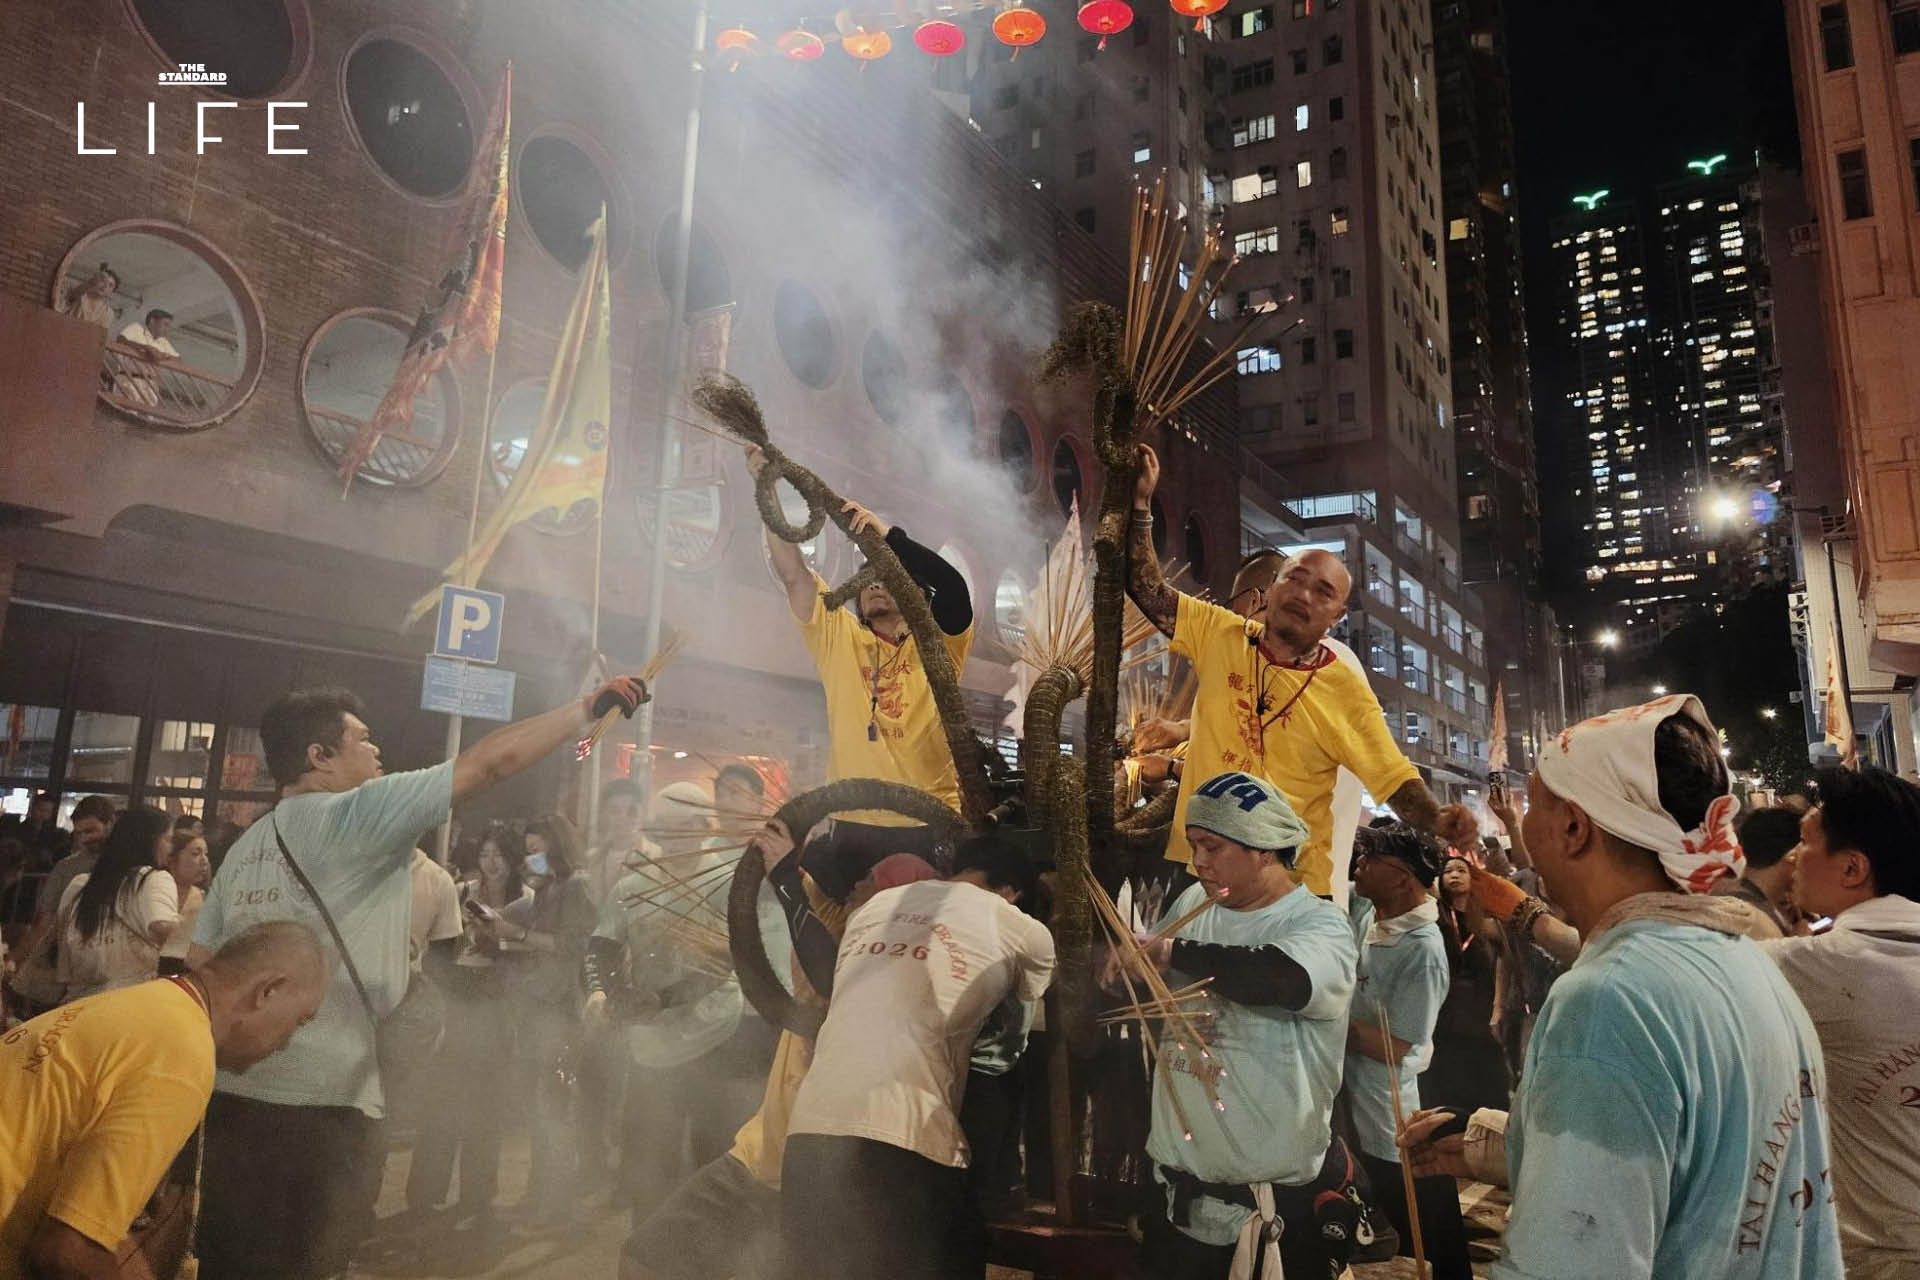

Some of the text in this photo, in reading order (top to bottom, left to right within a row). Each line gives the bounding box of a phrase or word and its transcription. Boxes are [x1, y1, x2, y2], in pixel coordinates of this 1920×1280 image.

[448, 594, 491, 650] P
[854, 941, 931, 961] 2026
[1879, 1043, 1920, 1080] HAN
[1737, 1093, 1801, 1256] TAI HANG
